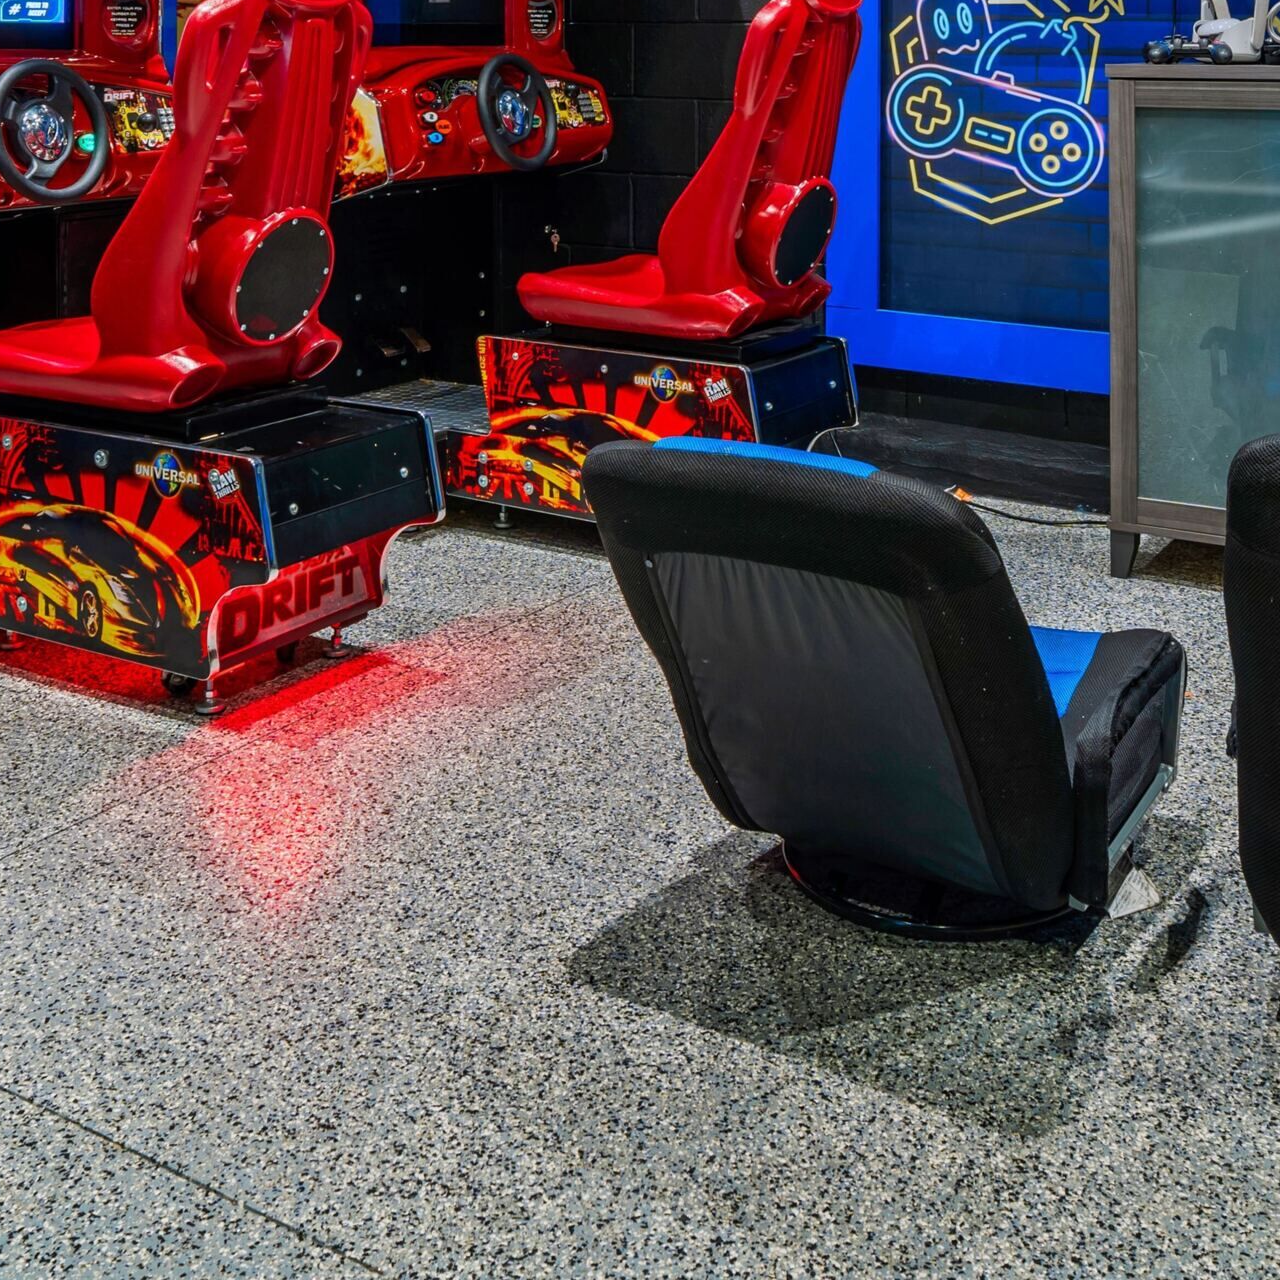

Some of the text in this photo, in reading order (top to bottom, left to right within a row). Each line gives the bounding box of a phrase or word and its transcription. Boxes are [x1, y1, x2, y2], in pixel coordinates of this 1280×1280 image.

[103, 92, 135, 102] DRIFT
[634, 376, 695, 392] UNIVERSAL
[704, 378, 728, 396] RAW
[135, 463, 200, 486] UNIVERSAL
[215, 481, 240, 499] THRILLS
[221, 555, 360, 648] DRIFT
